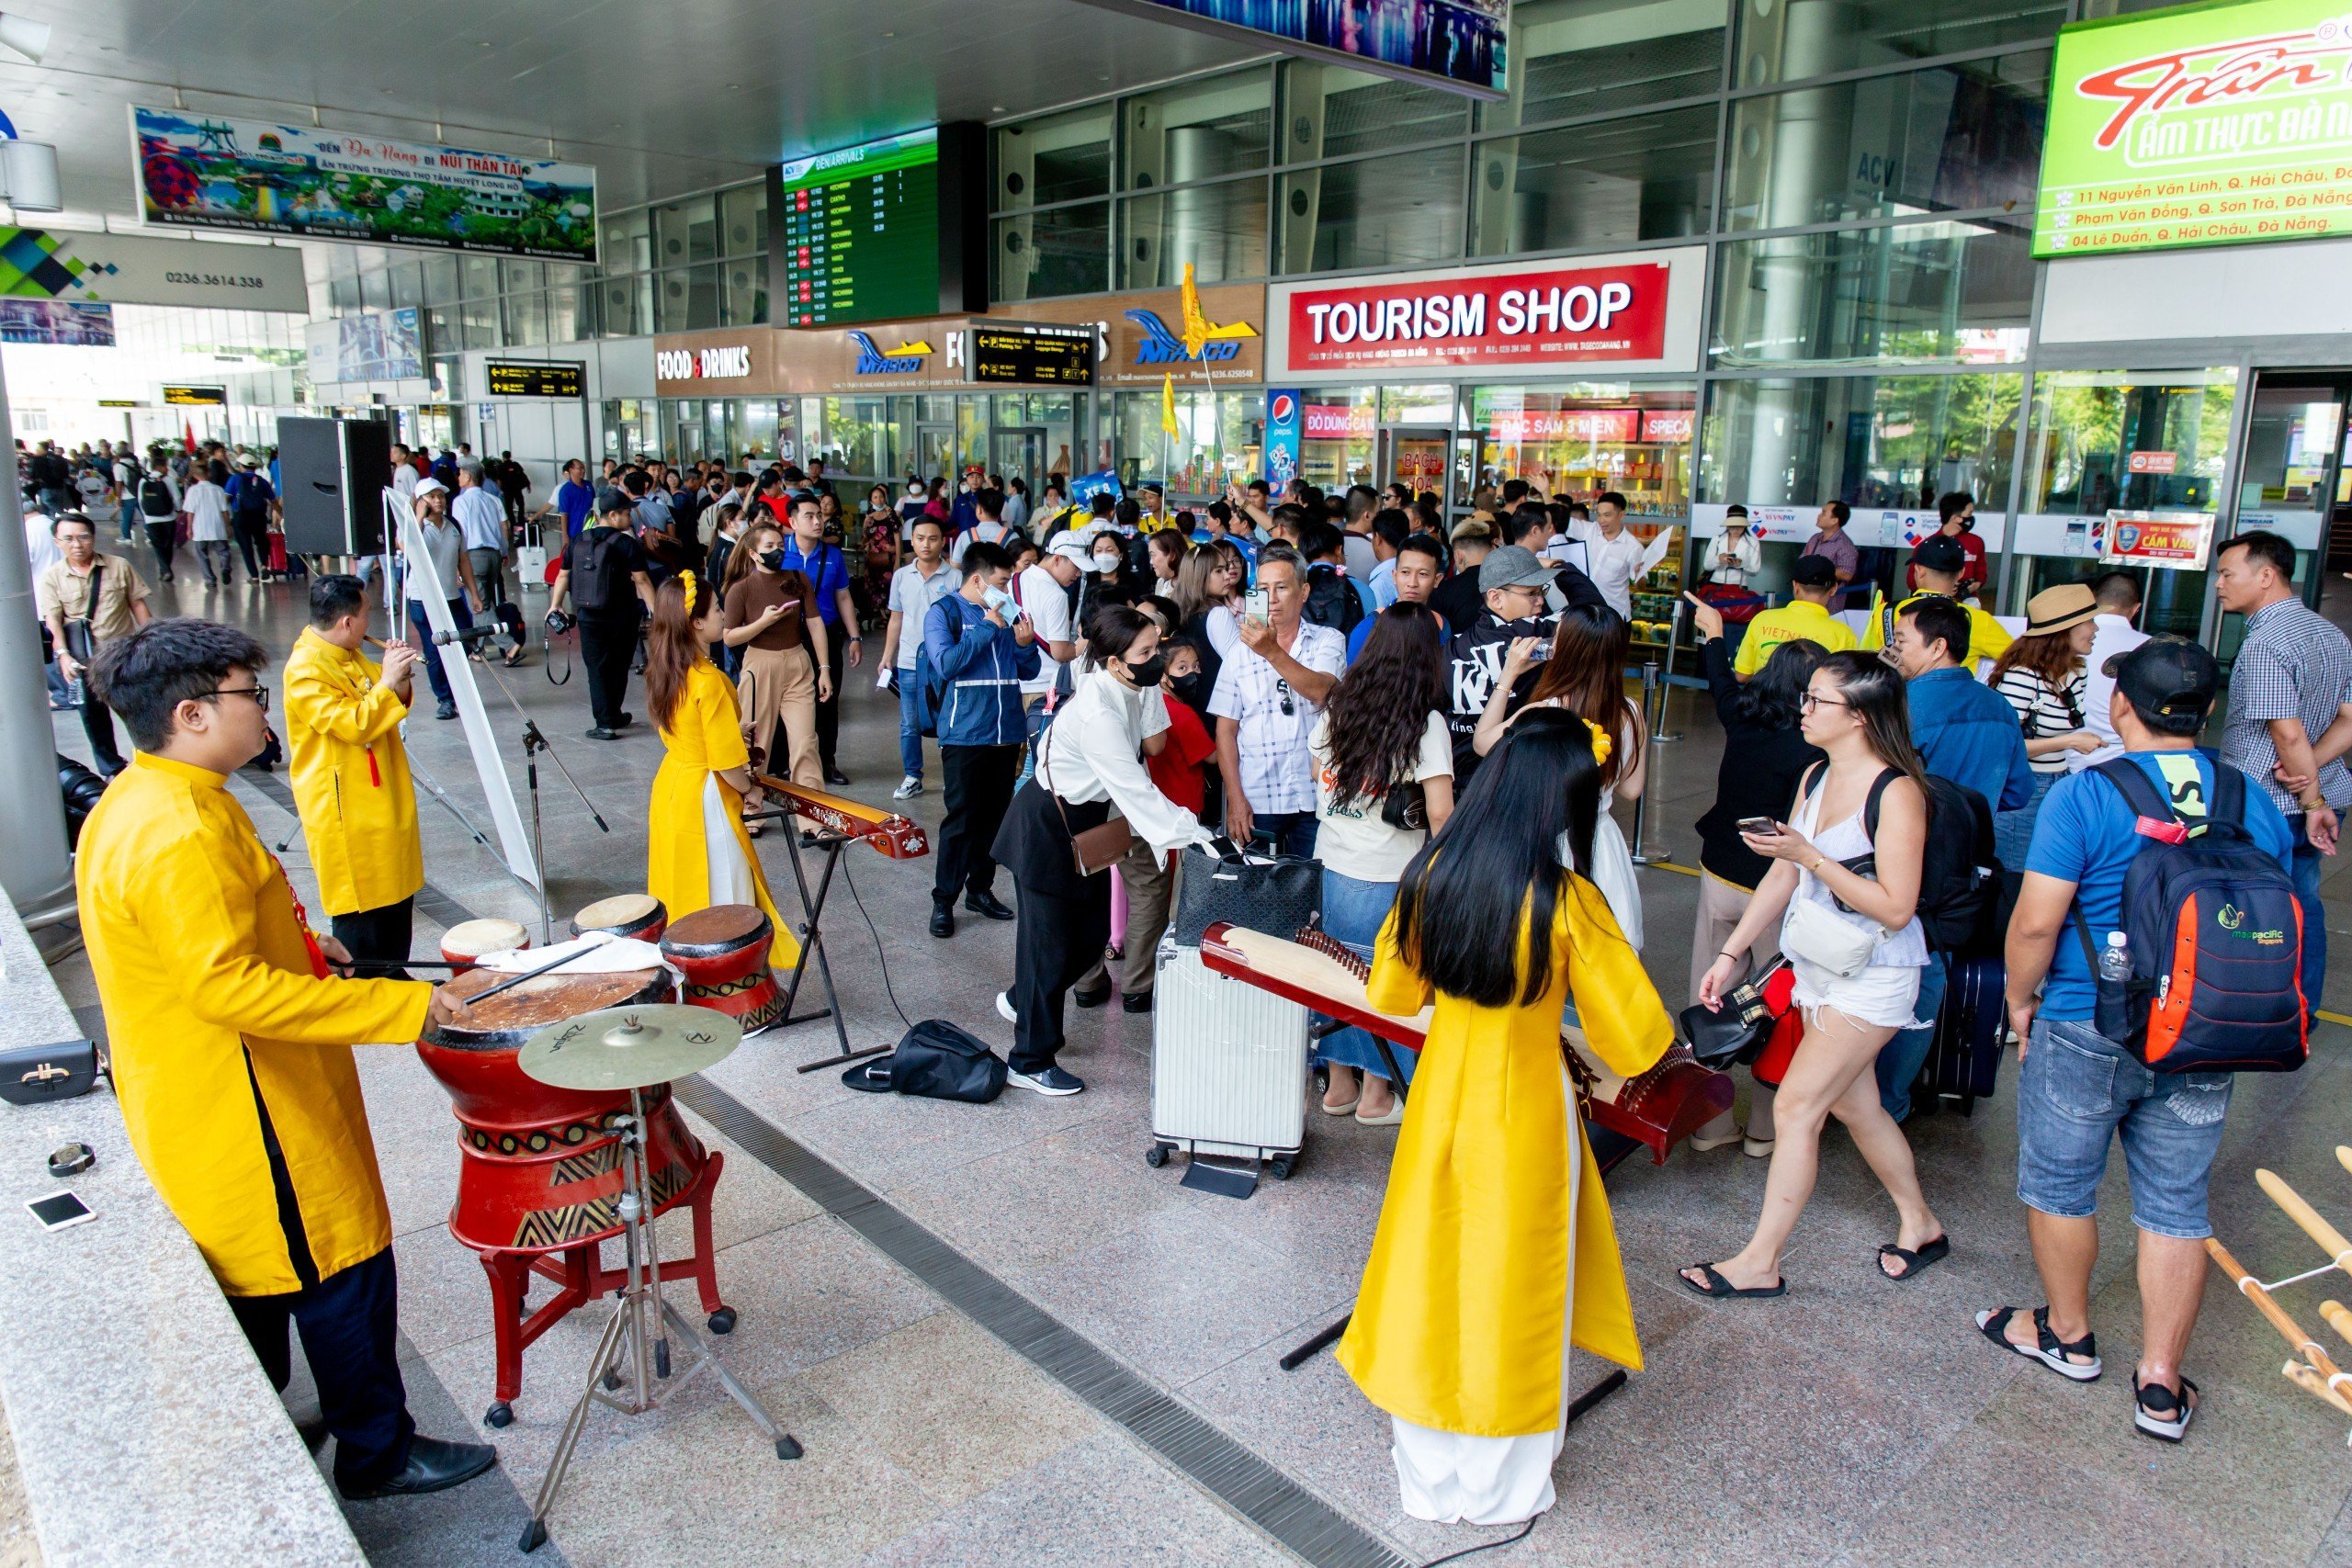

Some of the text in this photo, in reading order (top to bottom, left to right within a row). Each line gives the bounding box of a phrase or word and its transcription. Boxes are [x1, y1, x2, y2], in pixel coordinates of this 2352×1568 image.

[1857, 152, 1896, 187] ACV
[2080, 191, 2093, 203] 11
[2098, 184, 2151, 204] Nguyễn
[2157, 184, 2184, 196] Văn
[2189, 180, 2222, 193] Linh,
[2228, 177, 2244, 189] Q.
[2250, 173, 2276, 187] Hải
[2281, 169, 2328, 184] Châu,
[2075, 214, 2113, 227] Phạm
[2120, 209, 2145, 221] Văn
[2199, 203, 2214, 215] Q.
[2220, 200, 2246, 213] Sơn
[2253, 197, 2278, 210] Trà,
[2285, 194, 2307, 208] Đà
[2073, 235, 2088, 247] 04
[2093, 233, 2107, 245] Lê
[2157, 229, 2172, 240] Q.
[2178, 226, 2202, 239] Hải
[2208, 223, 2252, 237] Châu,
[2257, 220, 2279, 233] Đà
[165, 272, 264, 288] 0236.3614.338
[1306, 282, 1632, 345] TOURISM SHOP
[657, 350, 693, 380] FOOD
[701, 345, 752, 378] DRINKS
[1102, 482, 1111, 494] 8
[2233, 930, 2283, 940] mappacific
